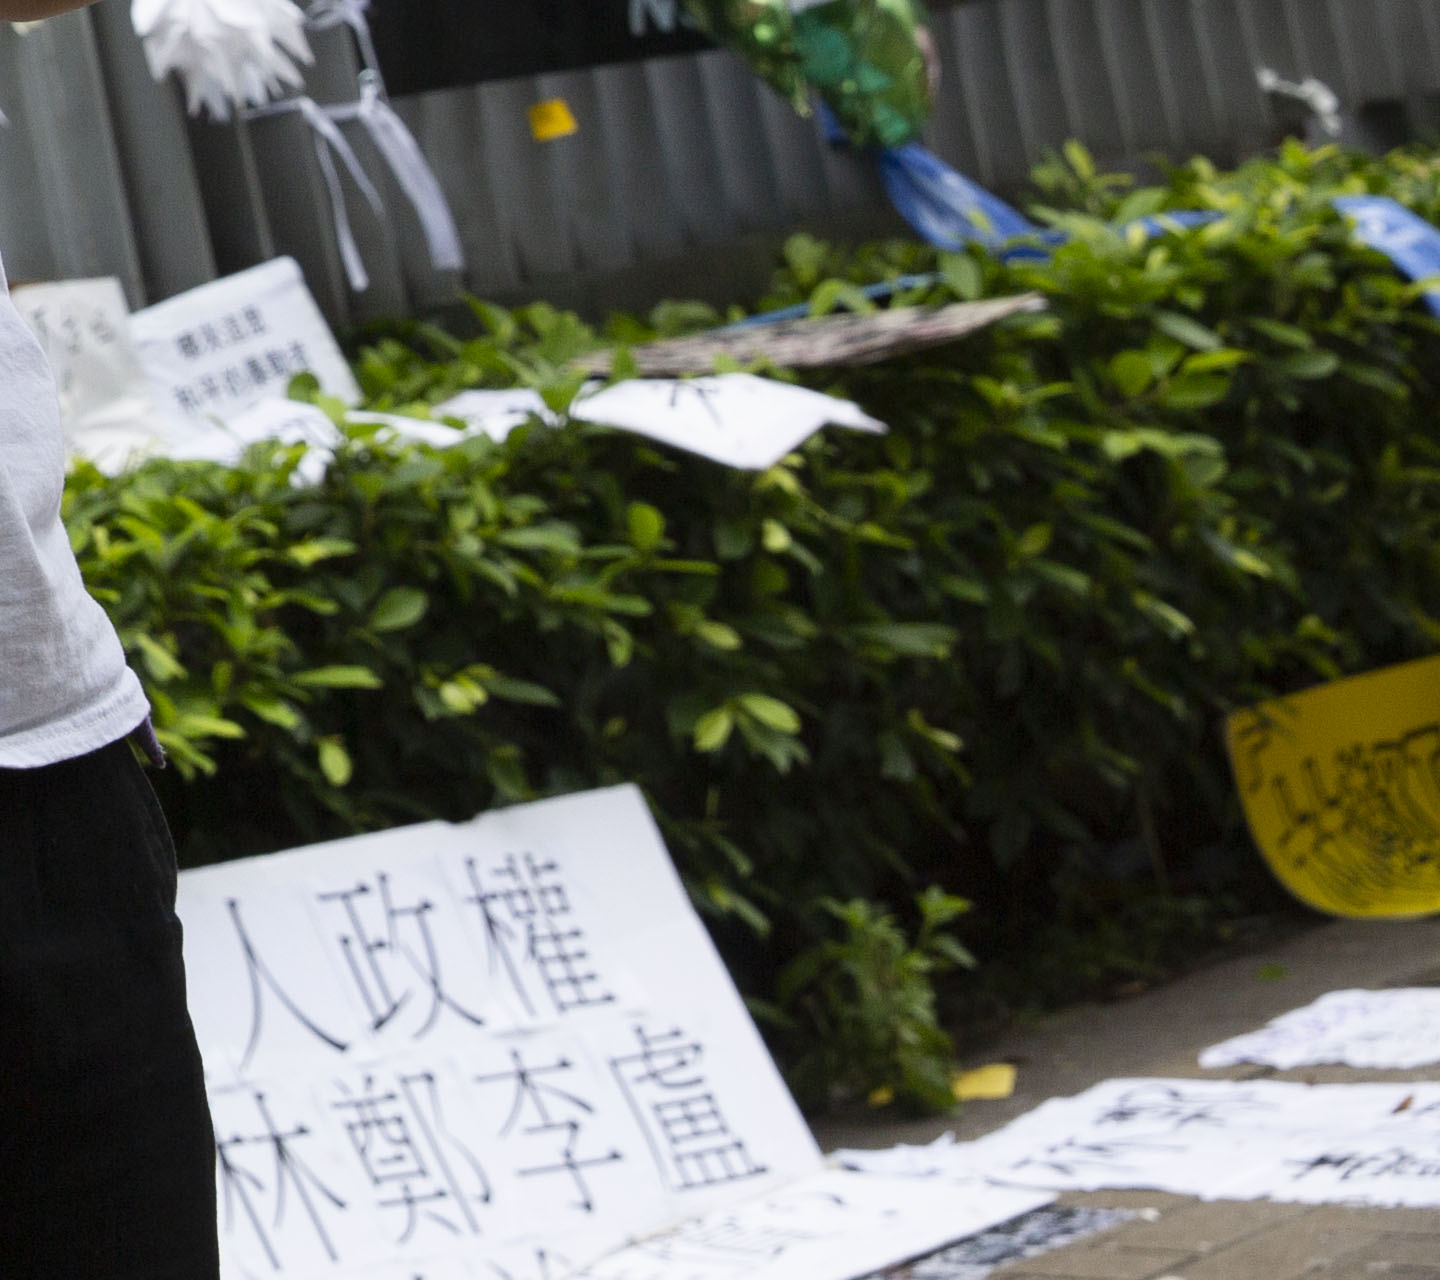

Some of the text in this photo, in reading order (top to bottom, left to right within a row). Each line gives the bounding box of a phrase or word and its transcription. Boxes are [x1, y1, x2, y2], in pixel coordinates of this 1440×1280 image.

[226, 850, 618, 1072] 人政權
[215, 1022, 771, 1272] 林鄭李盧
